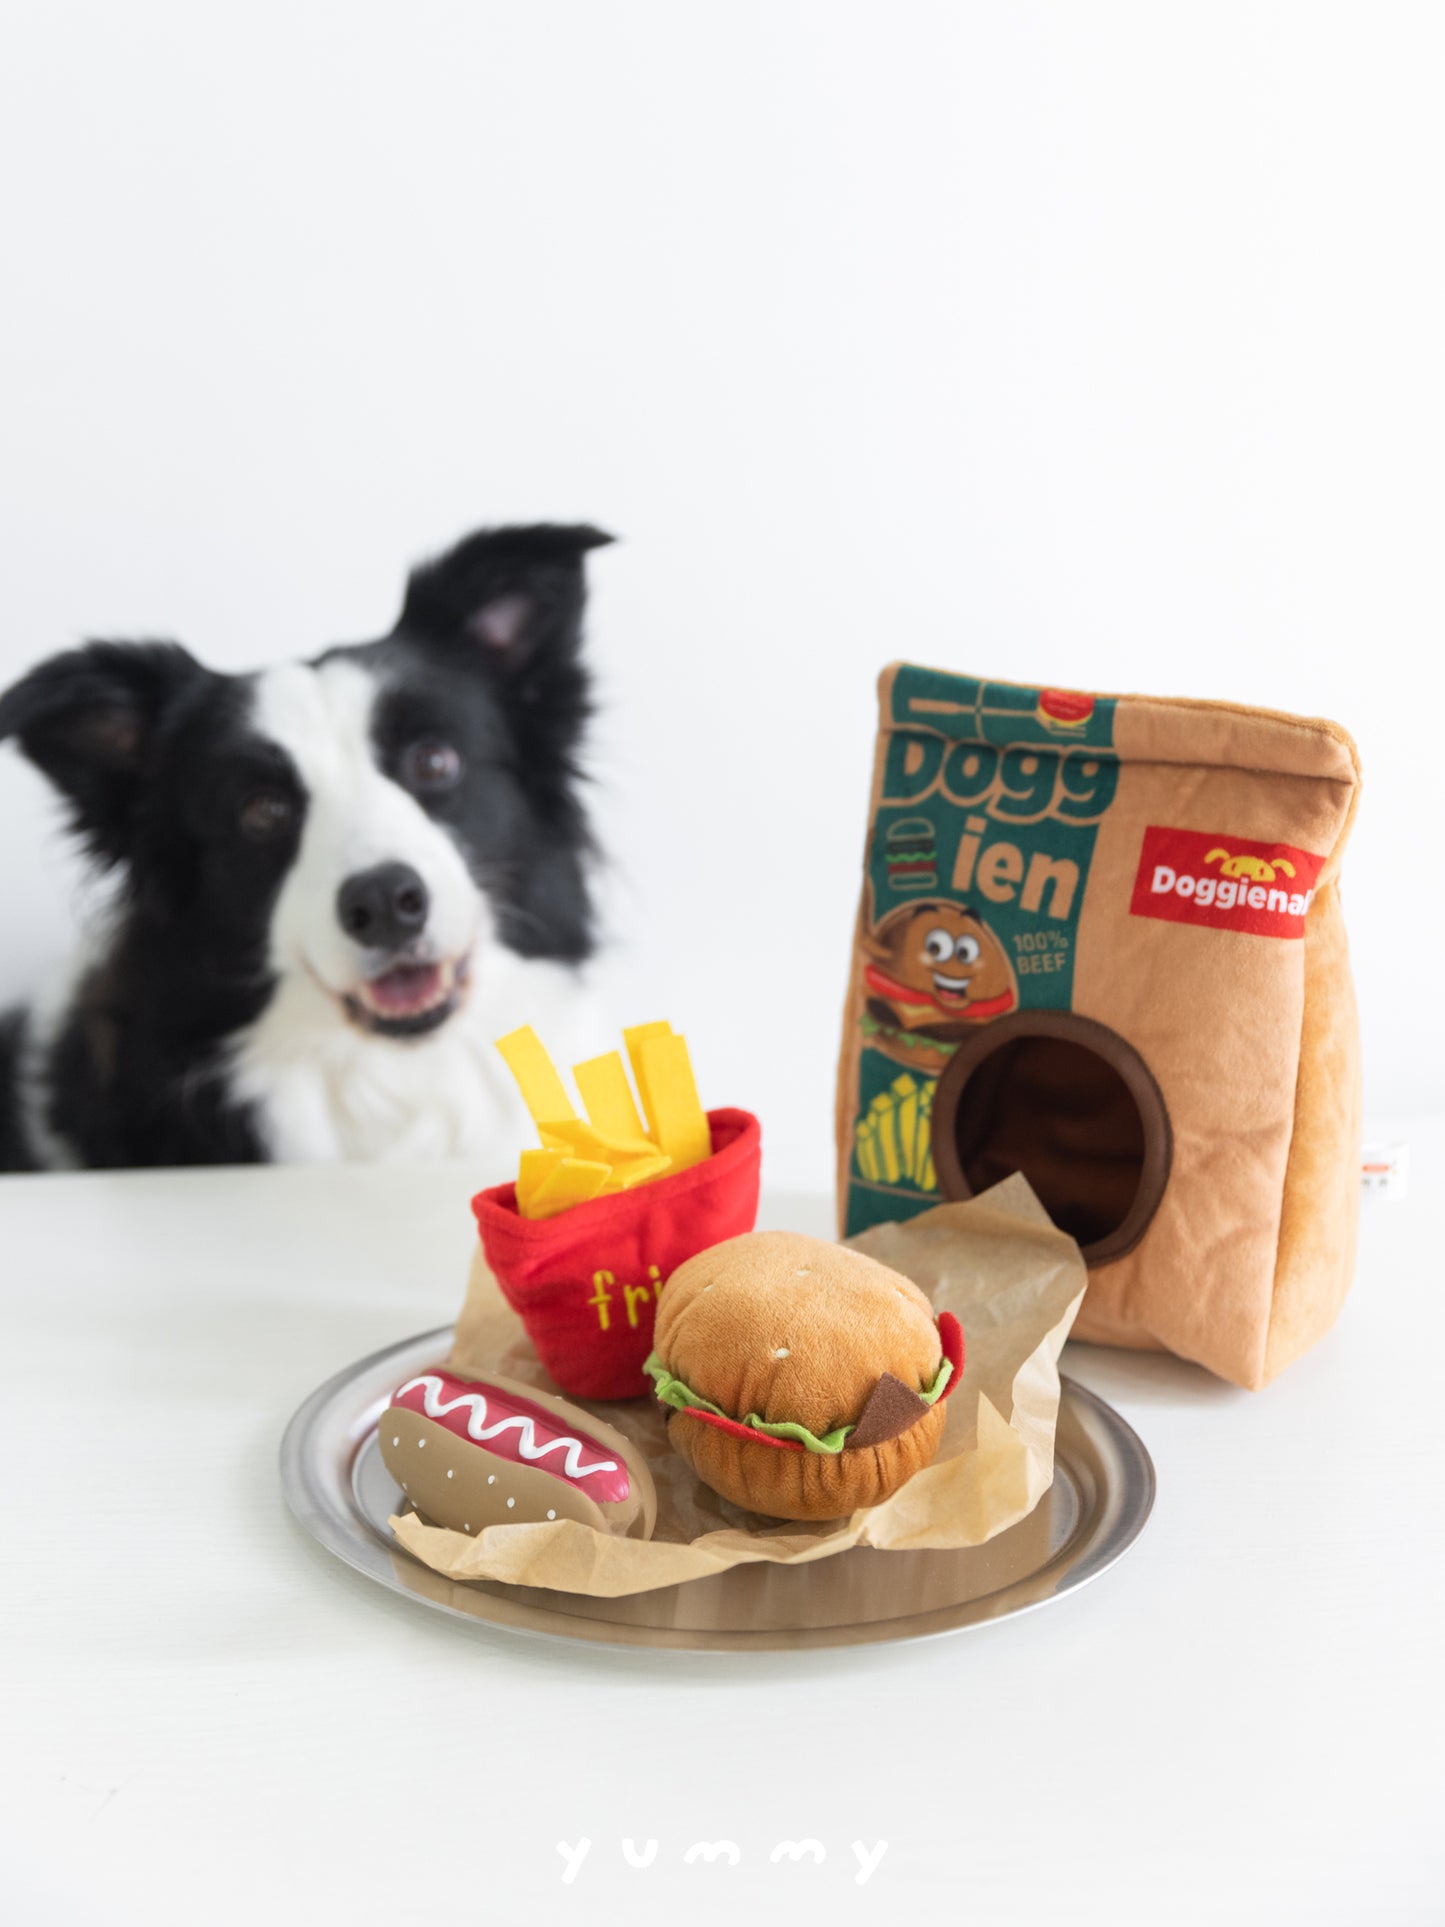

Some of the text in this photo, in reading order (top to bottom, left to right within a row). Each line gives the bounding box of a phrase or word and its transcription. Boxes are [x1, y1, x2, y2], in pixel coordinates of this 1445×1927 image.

[879, 728, 1120, 822] Dogg
[951, 814, 1080, 921] ien
[1013, 930, 1069, 952] 100%
[1016, 952, 1066, 975] BEEF
